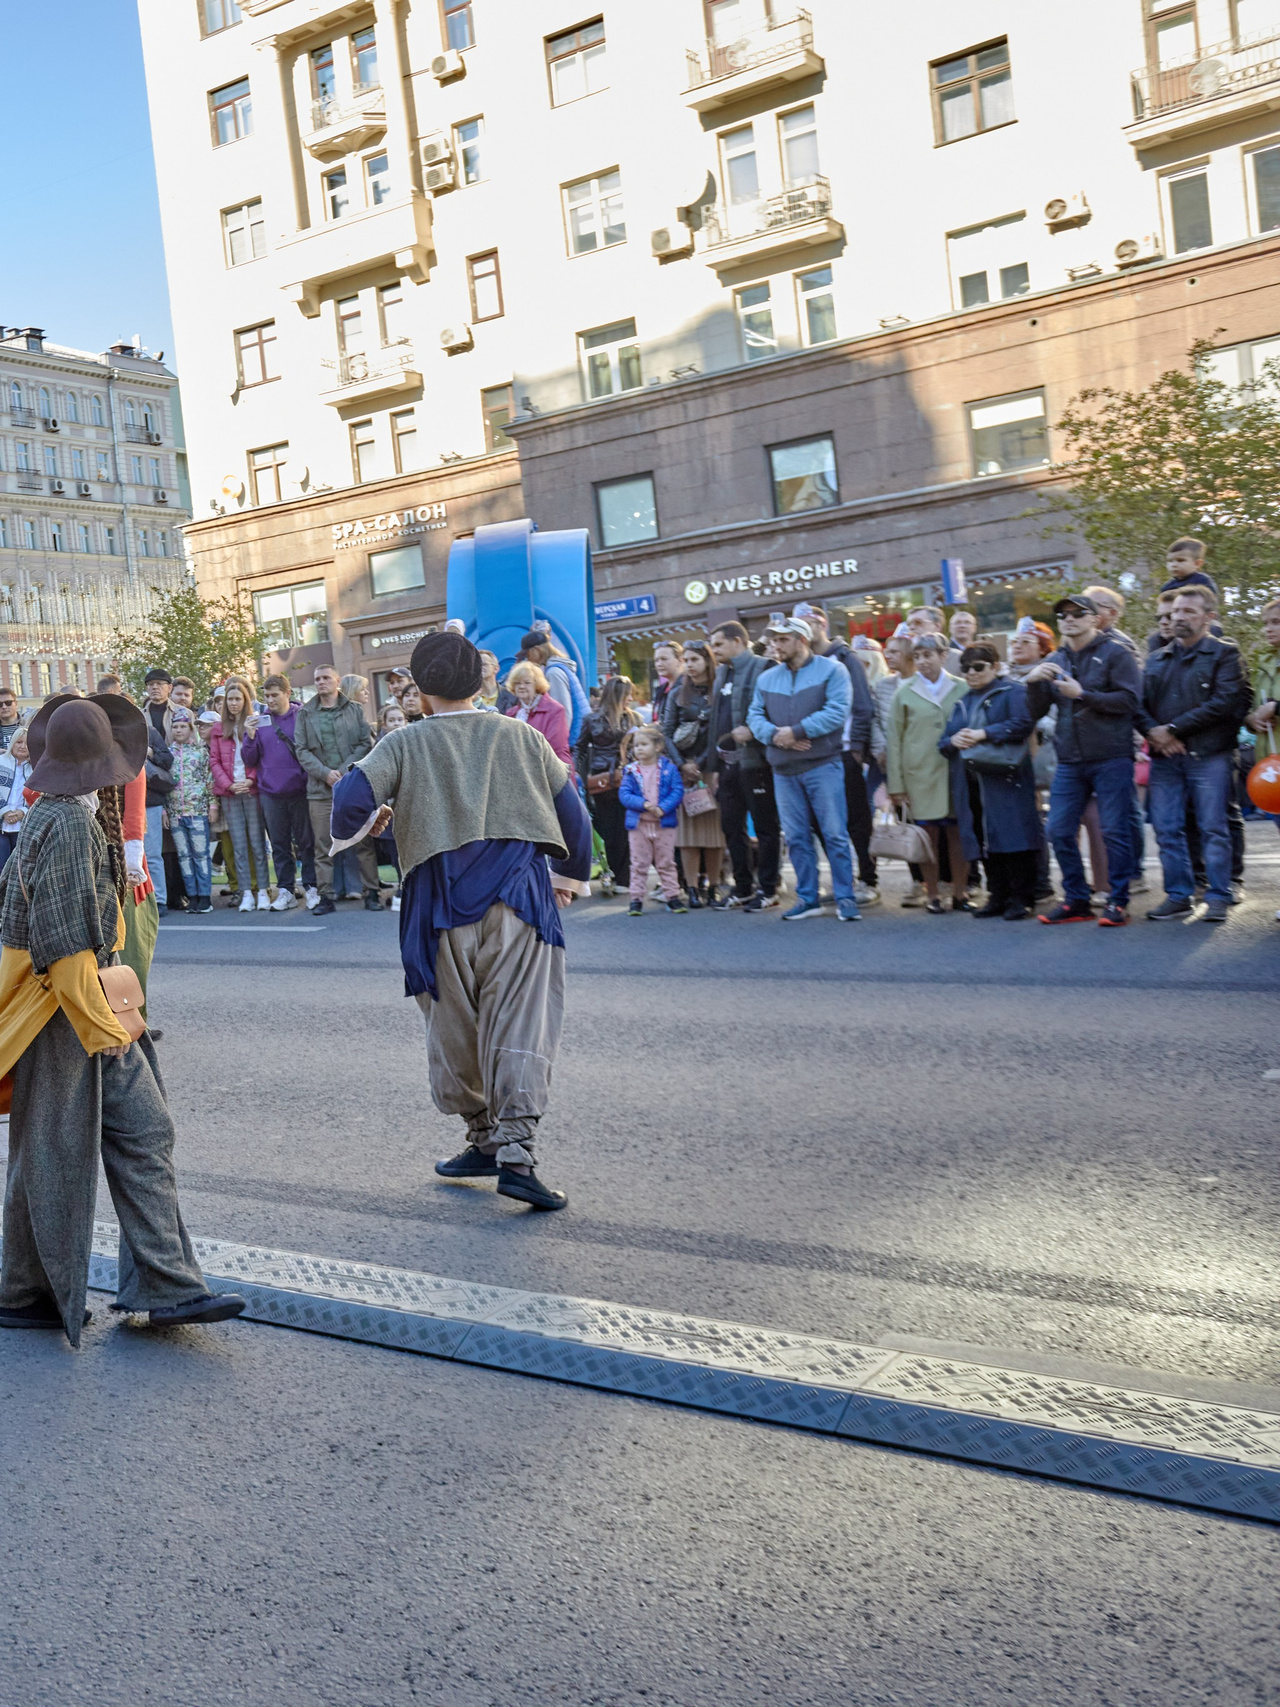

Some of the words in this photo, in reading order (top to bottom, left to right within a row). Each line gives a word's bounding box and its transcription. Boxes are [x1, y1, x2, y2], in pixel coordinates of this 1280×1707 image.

[331, 502, 447, 541] SPA-САЛОН
[332, 532, 395, 550] РАСТИТЕЛЬНОЙ
[397, 522, 448, 537] КОСМЕТИКИ
[710, 574, 763, 594] YVES
[768, 558, 859, 586] ROCHER
[754, 581, 813, 597] FRANCE
[594, 602, 627, 614] ВЕРСКАЯ
[640, 599, 650, 611] 4
[381, 635, 400, 644] YVES
